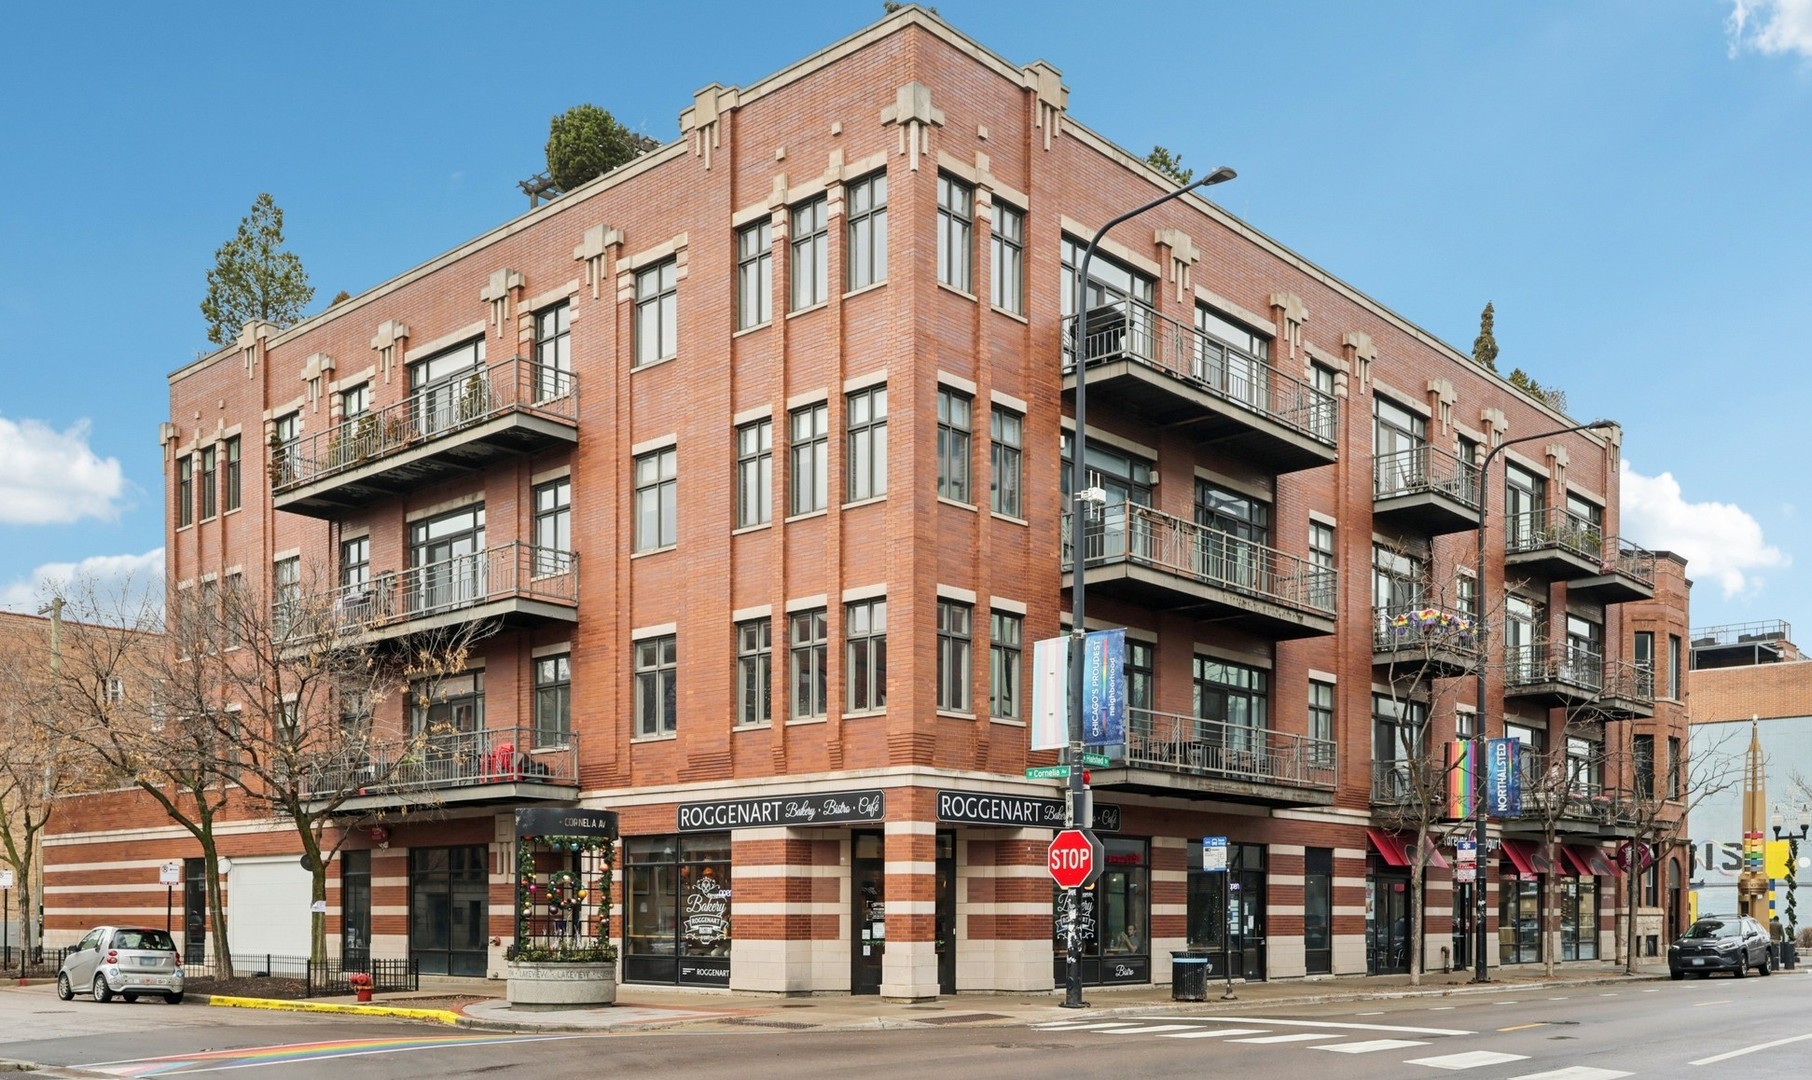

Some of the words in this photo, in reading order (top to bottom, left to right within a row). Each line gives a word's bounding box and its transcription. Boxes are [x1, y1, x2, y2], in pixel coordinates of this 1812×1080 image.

[1092, 641, 1100, 687] PROUDEST
[1108, 657, 1116, 716] neighborhood
[1033, 768, 1060, 778] Cornelia
[1496, 743, 1507, 812] NORTHALSTED
[681, 802, 782, 827] ROGGENART
[785, 801, 816, 821] Bakery
[823, 799, 851, 816] Bistro
[858, 795, 880, 818] Café
[941, 795, 1042, 822] ROGGENART
[1043, 804, 1066, 826] Bake
[1051, 848, 1090, 870] STOP
[1229, 882, 1240, 892] pen
[686, 893, 727, 917] Bakery
[691, 916, 721, 925] ROGGENART
[696, 968, 730, 977] ROGGENART
[1115, 964, 1135, 977] Bistro
